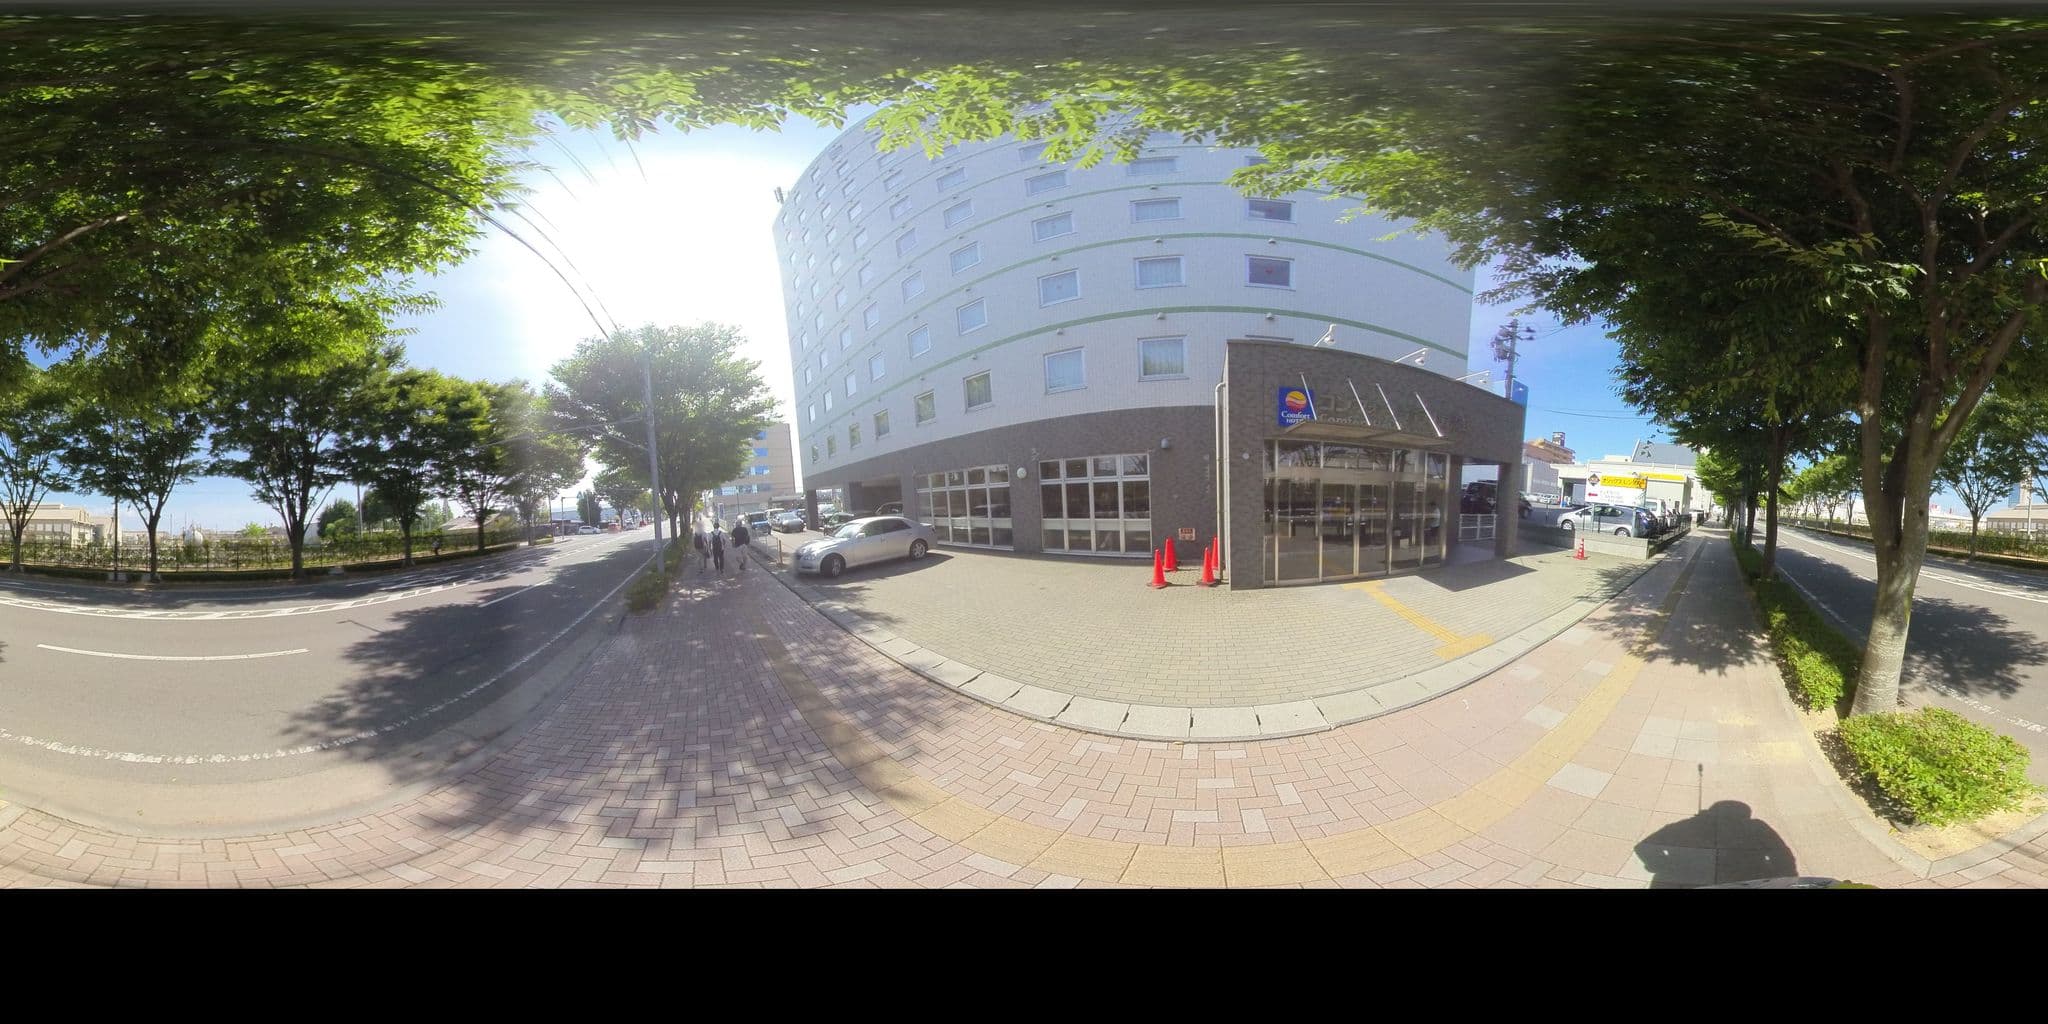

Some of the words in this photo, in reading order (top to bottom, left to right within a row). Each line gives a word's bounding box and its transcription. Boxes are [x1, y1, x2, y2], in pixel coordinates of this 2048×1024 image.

[1281, 411, 1310, 419] Comfort
[1602, 477, 1646, 488] オリックスレン
